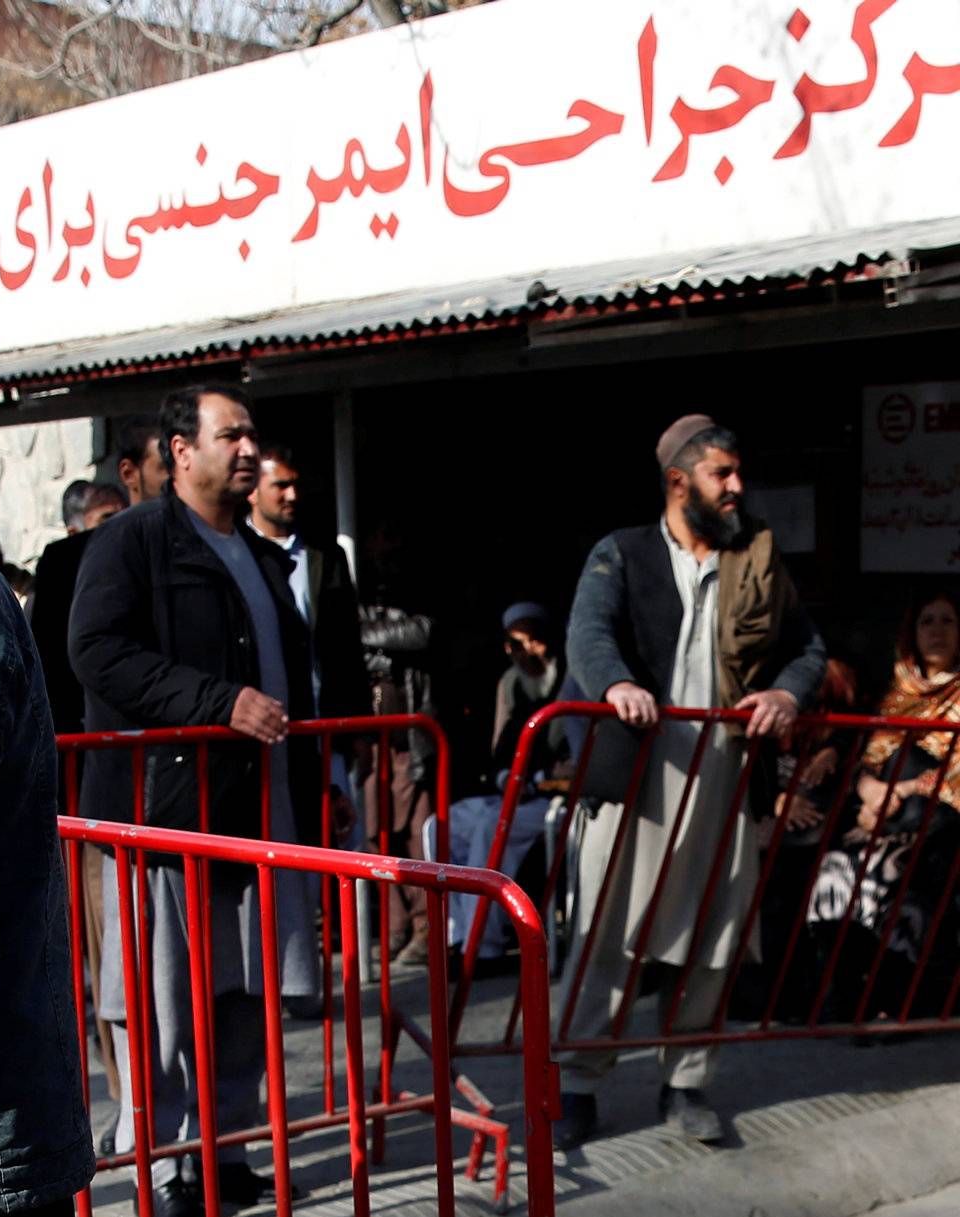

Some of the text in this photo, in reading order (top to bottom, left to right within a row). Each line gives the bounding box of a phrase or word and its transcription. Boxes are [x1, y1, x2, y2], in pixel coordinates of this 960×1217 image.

[102, 70, 435, 281] ایمرجنسی
[443, 15, 776, 218] جراحی
[773, 0, 960, 160] رکز
